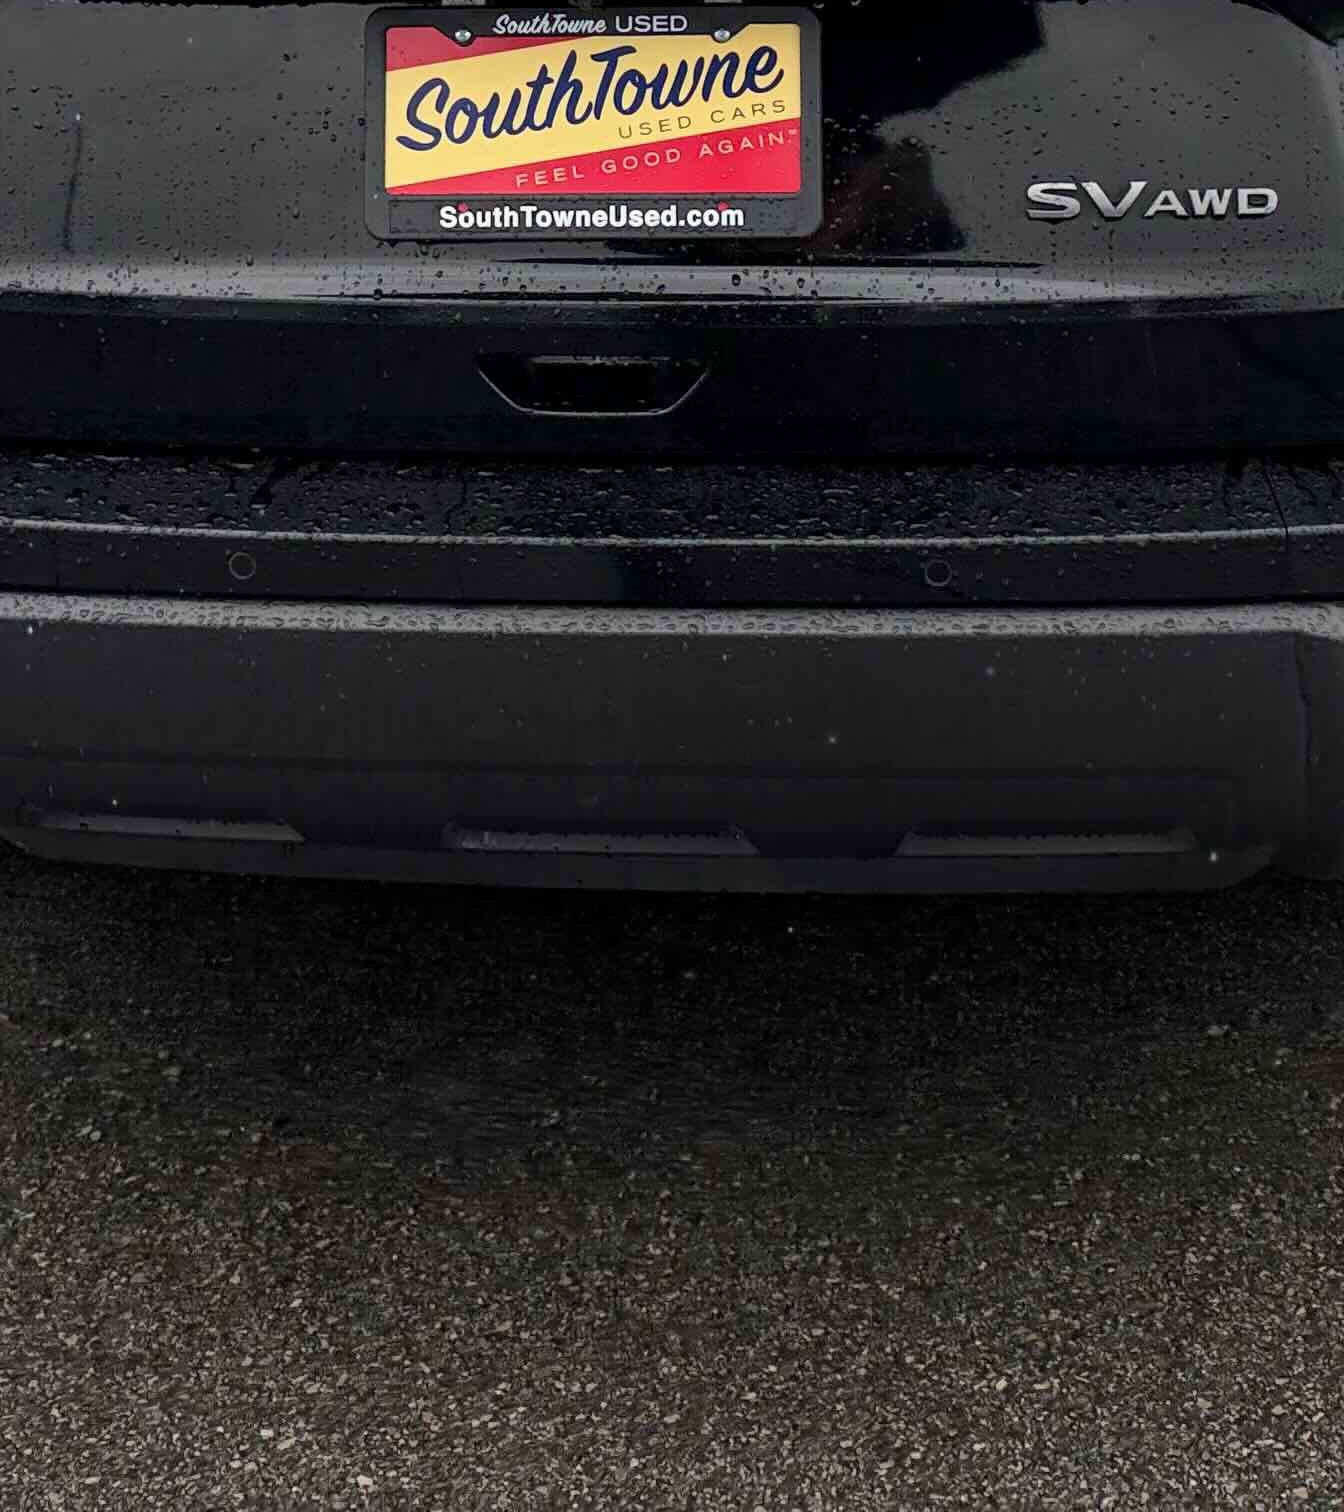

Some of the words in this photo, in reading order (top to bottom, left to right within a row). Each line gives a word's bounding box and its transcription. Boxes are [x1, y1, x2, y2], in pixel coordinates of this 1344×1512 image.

[493, 14, 607, 34] SouthTowne
[615, 15, 688, 32] USED
[396, 45, 785, 151] SouthTowne
[618, 115, 692, 140] USED
[711, 99, 787, 124] CARS
[516, 166, 585, 188] FEEL
[603, 148, 681, 175] GOOD
[439, 203, 745, 229] SouthTowneUsed.com
